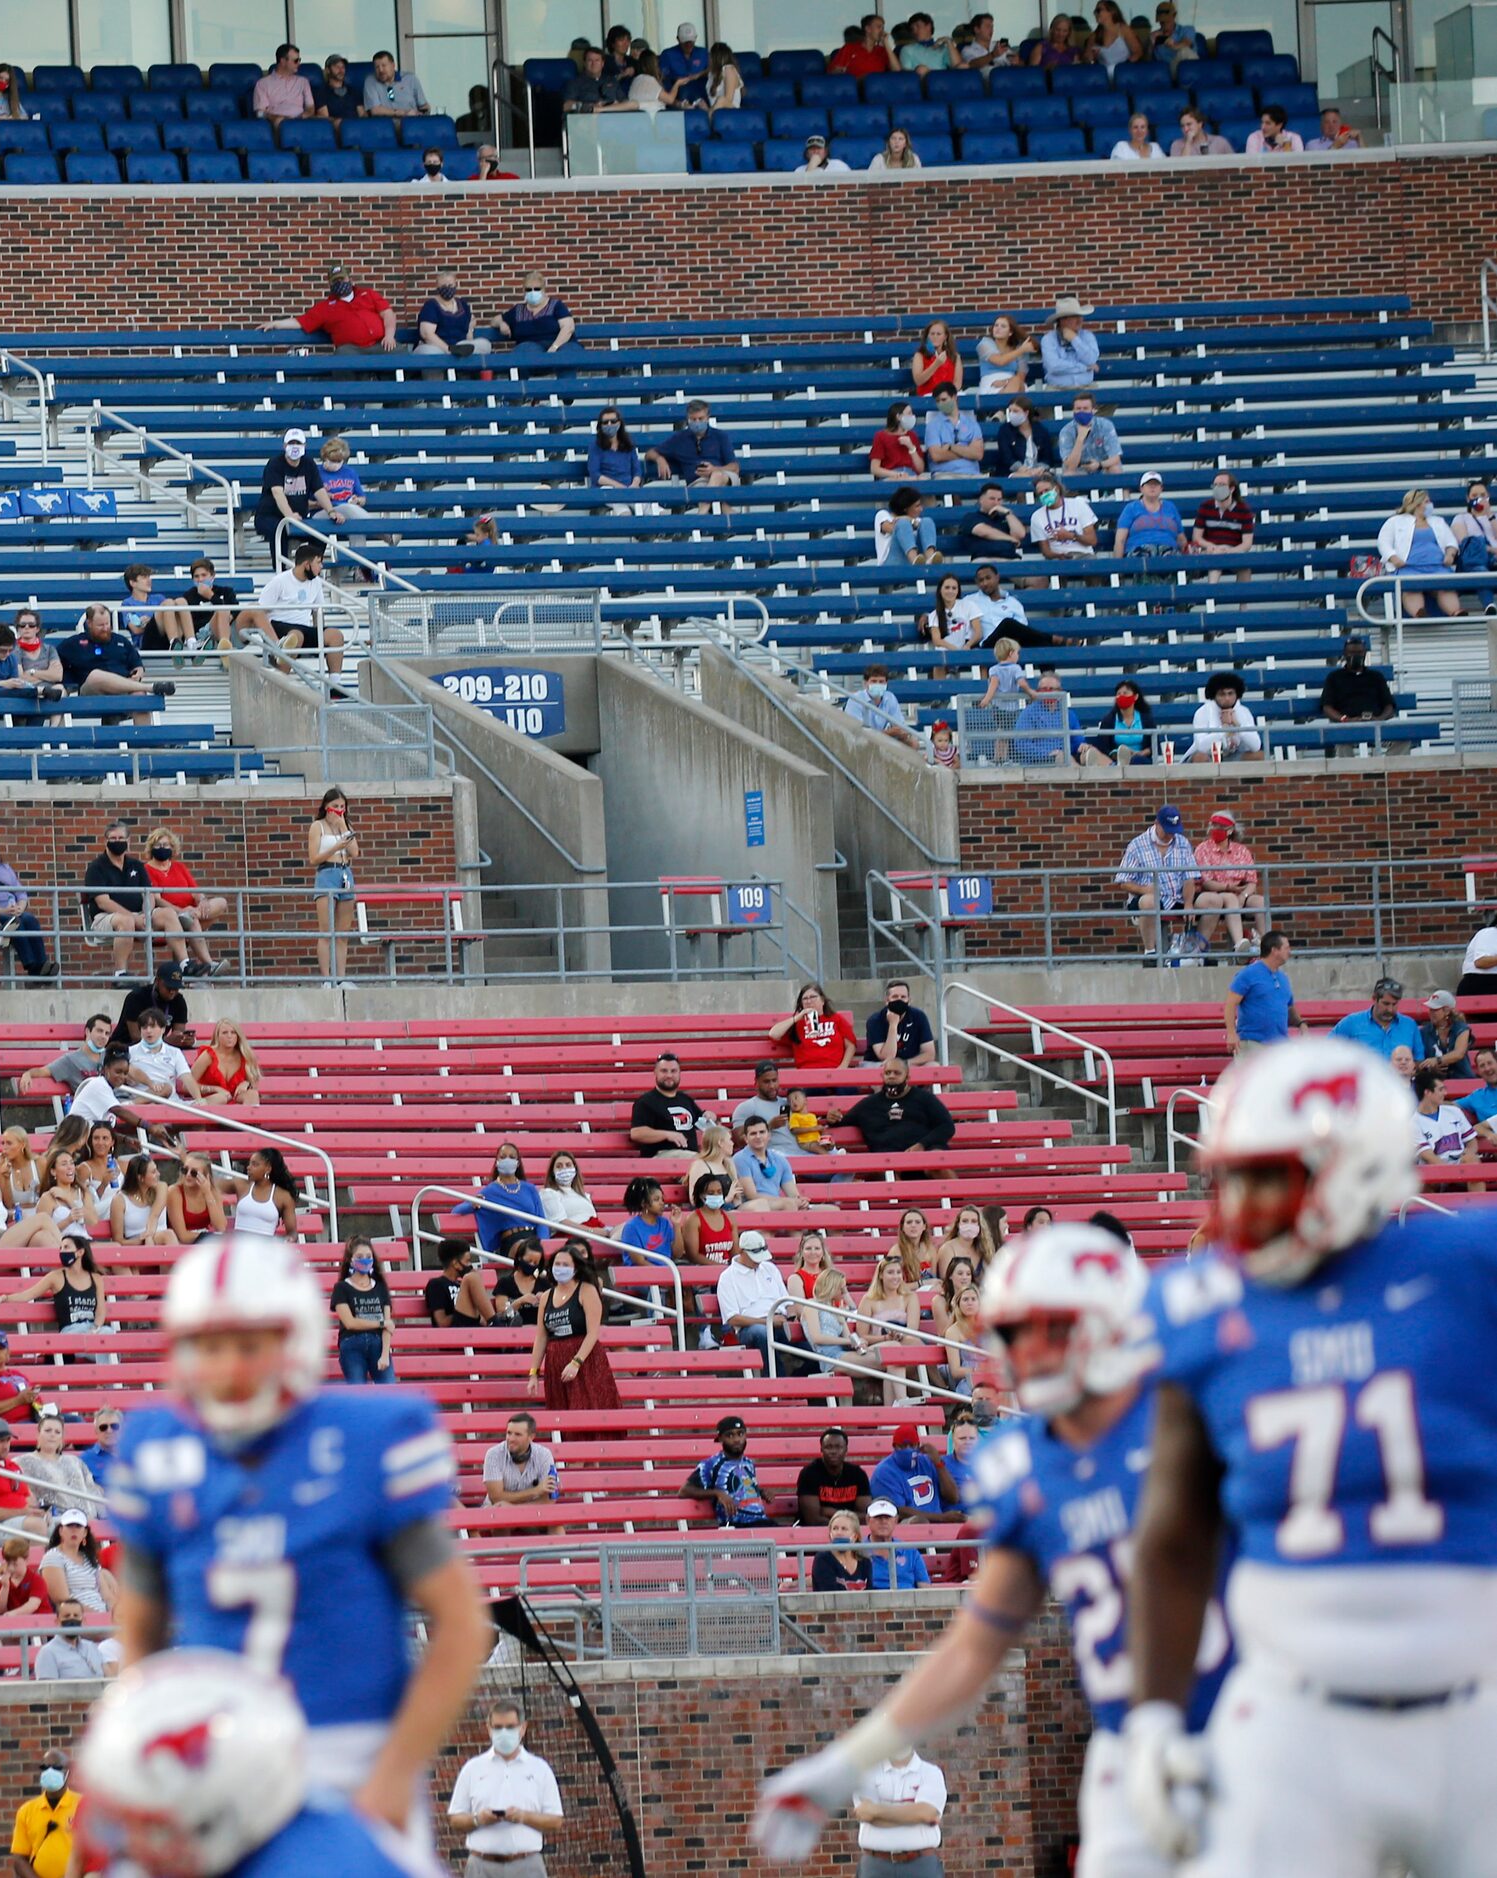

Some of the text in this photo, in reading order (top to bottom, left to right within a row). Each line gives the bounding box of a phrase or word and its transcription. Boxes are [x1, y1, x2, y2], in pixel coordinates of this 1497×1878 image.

[443, 675, 548, 701] 209-210
[737, 887, 763, 908] 109
[957, 878, 980, 899] 110
[1247, 1369, 1444, 1558] 71
[206, 1557, 297, 1678] 7
